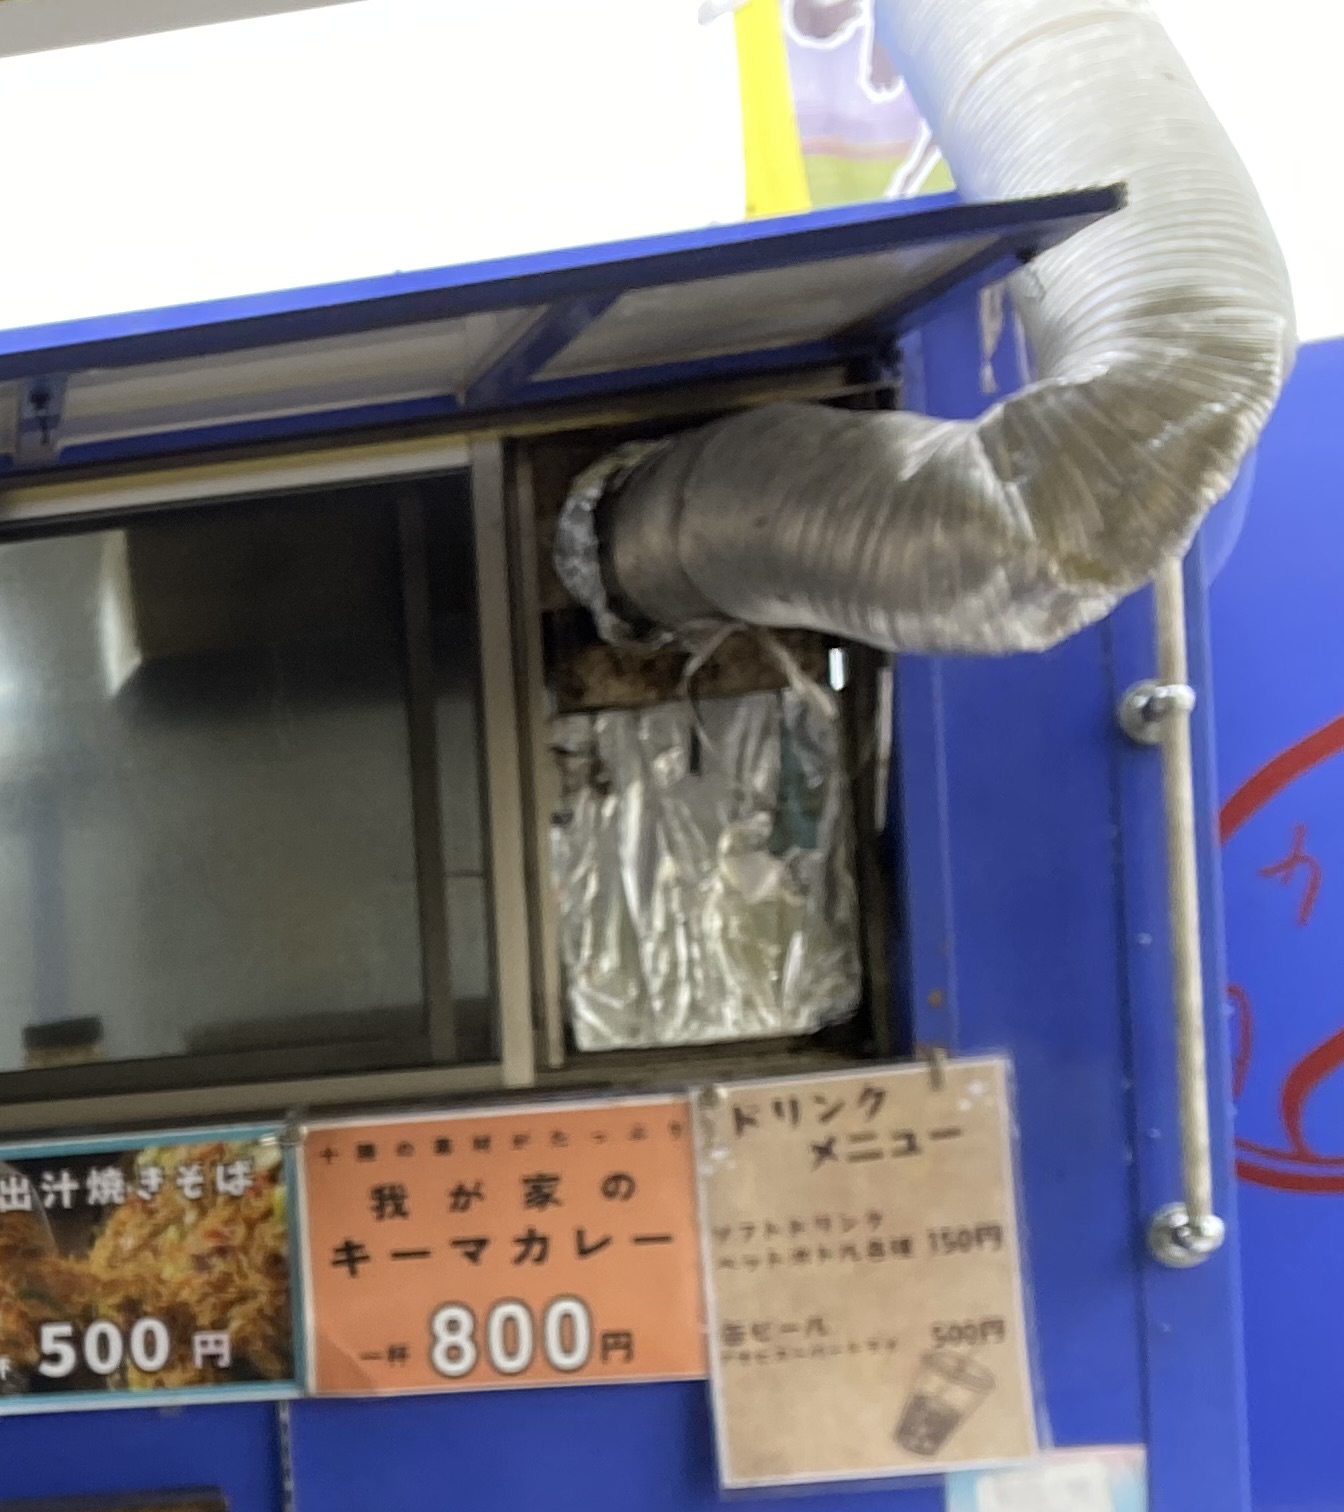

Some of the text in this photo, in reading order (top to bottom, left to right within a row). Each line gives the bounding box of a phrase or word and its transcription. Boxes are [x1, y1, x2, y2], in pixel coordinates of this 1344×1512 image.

[733, 1082, 886, 1136] ドリンク
[811, 1126, 962, 1170] メニュー
[370, 1172, 636, 1220] 我が家の
[331, 1227, 673, 1278] キーマカレー
[38, 1317, 170, 1378] 500
[193, 1329, 232, 1369] 円
